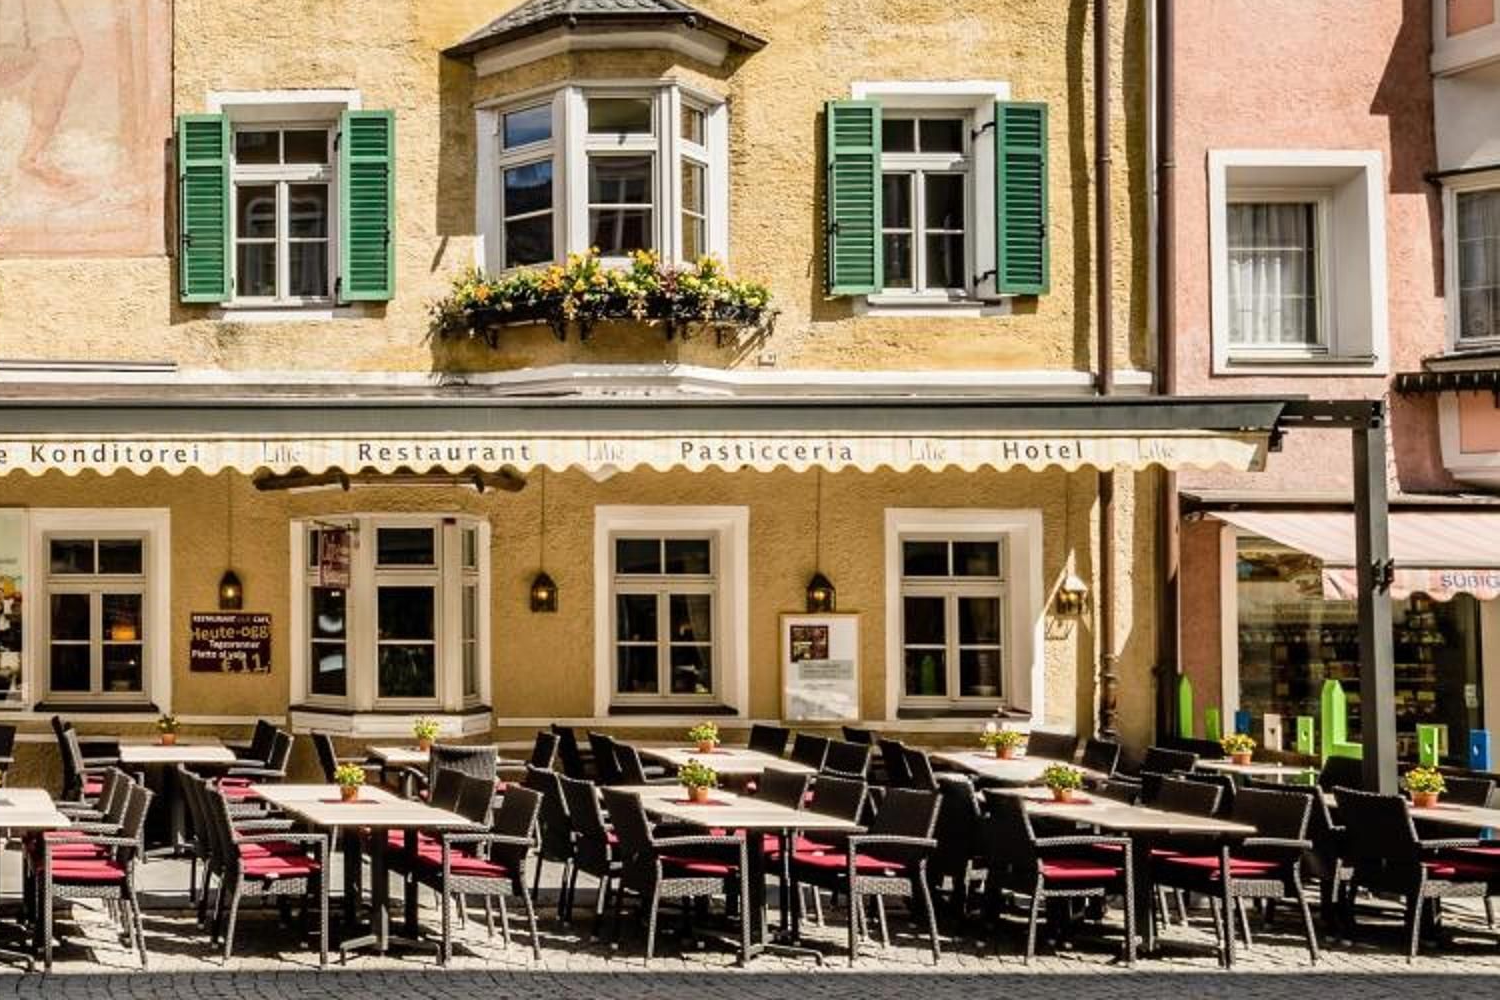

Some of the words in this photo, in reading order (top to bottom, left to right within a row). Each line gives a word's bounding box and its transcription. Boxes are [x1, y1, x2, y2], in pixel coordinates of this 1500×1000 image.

[31, 443, 200, 463] Konditorei
[359, 443, 531, 462] Restaurant
[681, 441, 853, 461] Pasticceria
[1003, 441, 1083, 459] Hotel
